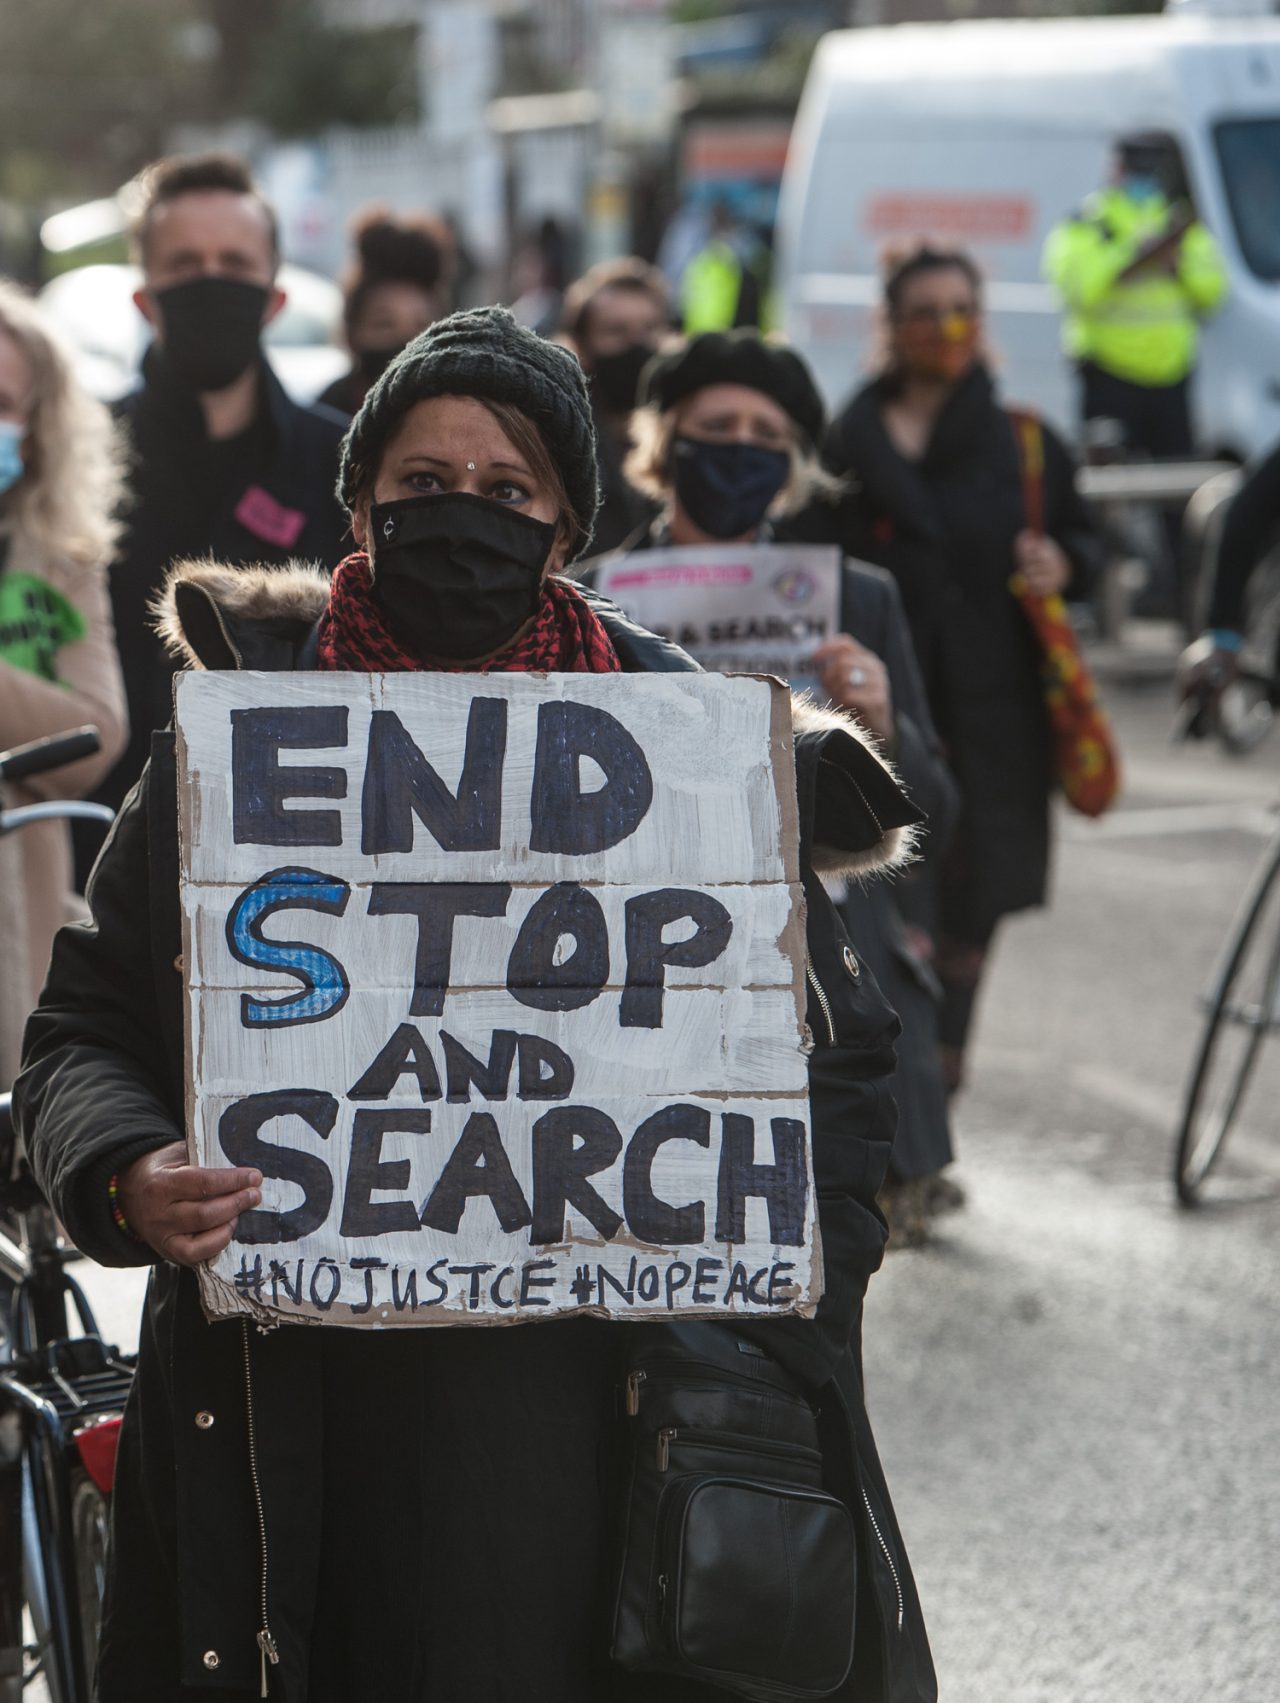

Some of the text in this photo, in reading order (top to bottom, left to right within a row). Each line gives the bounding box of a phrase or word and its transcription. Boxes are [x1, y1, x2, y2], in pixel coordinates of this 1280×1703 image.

[231, 696, 653, 855] END
[226, 866, 733, 1028] STOP
[347, 1023, 575, 1103] AND
[220, 1088, 807, 1246] SEARCH
[570, 1255, 797, 1311] #NOPEACE
